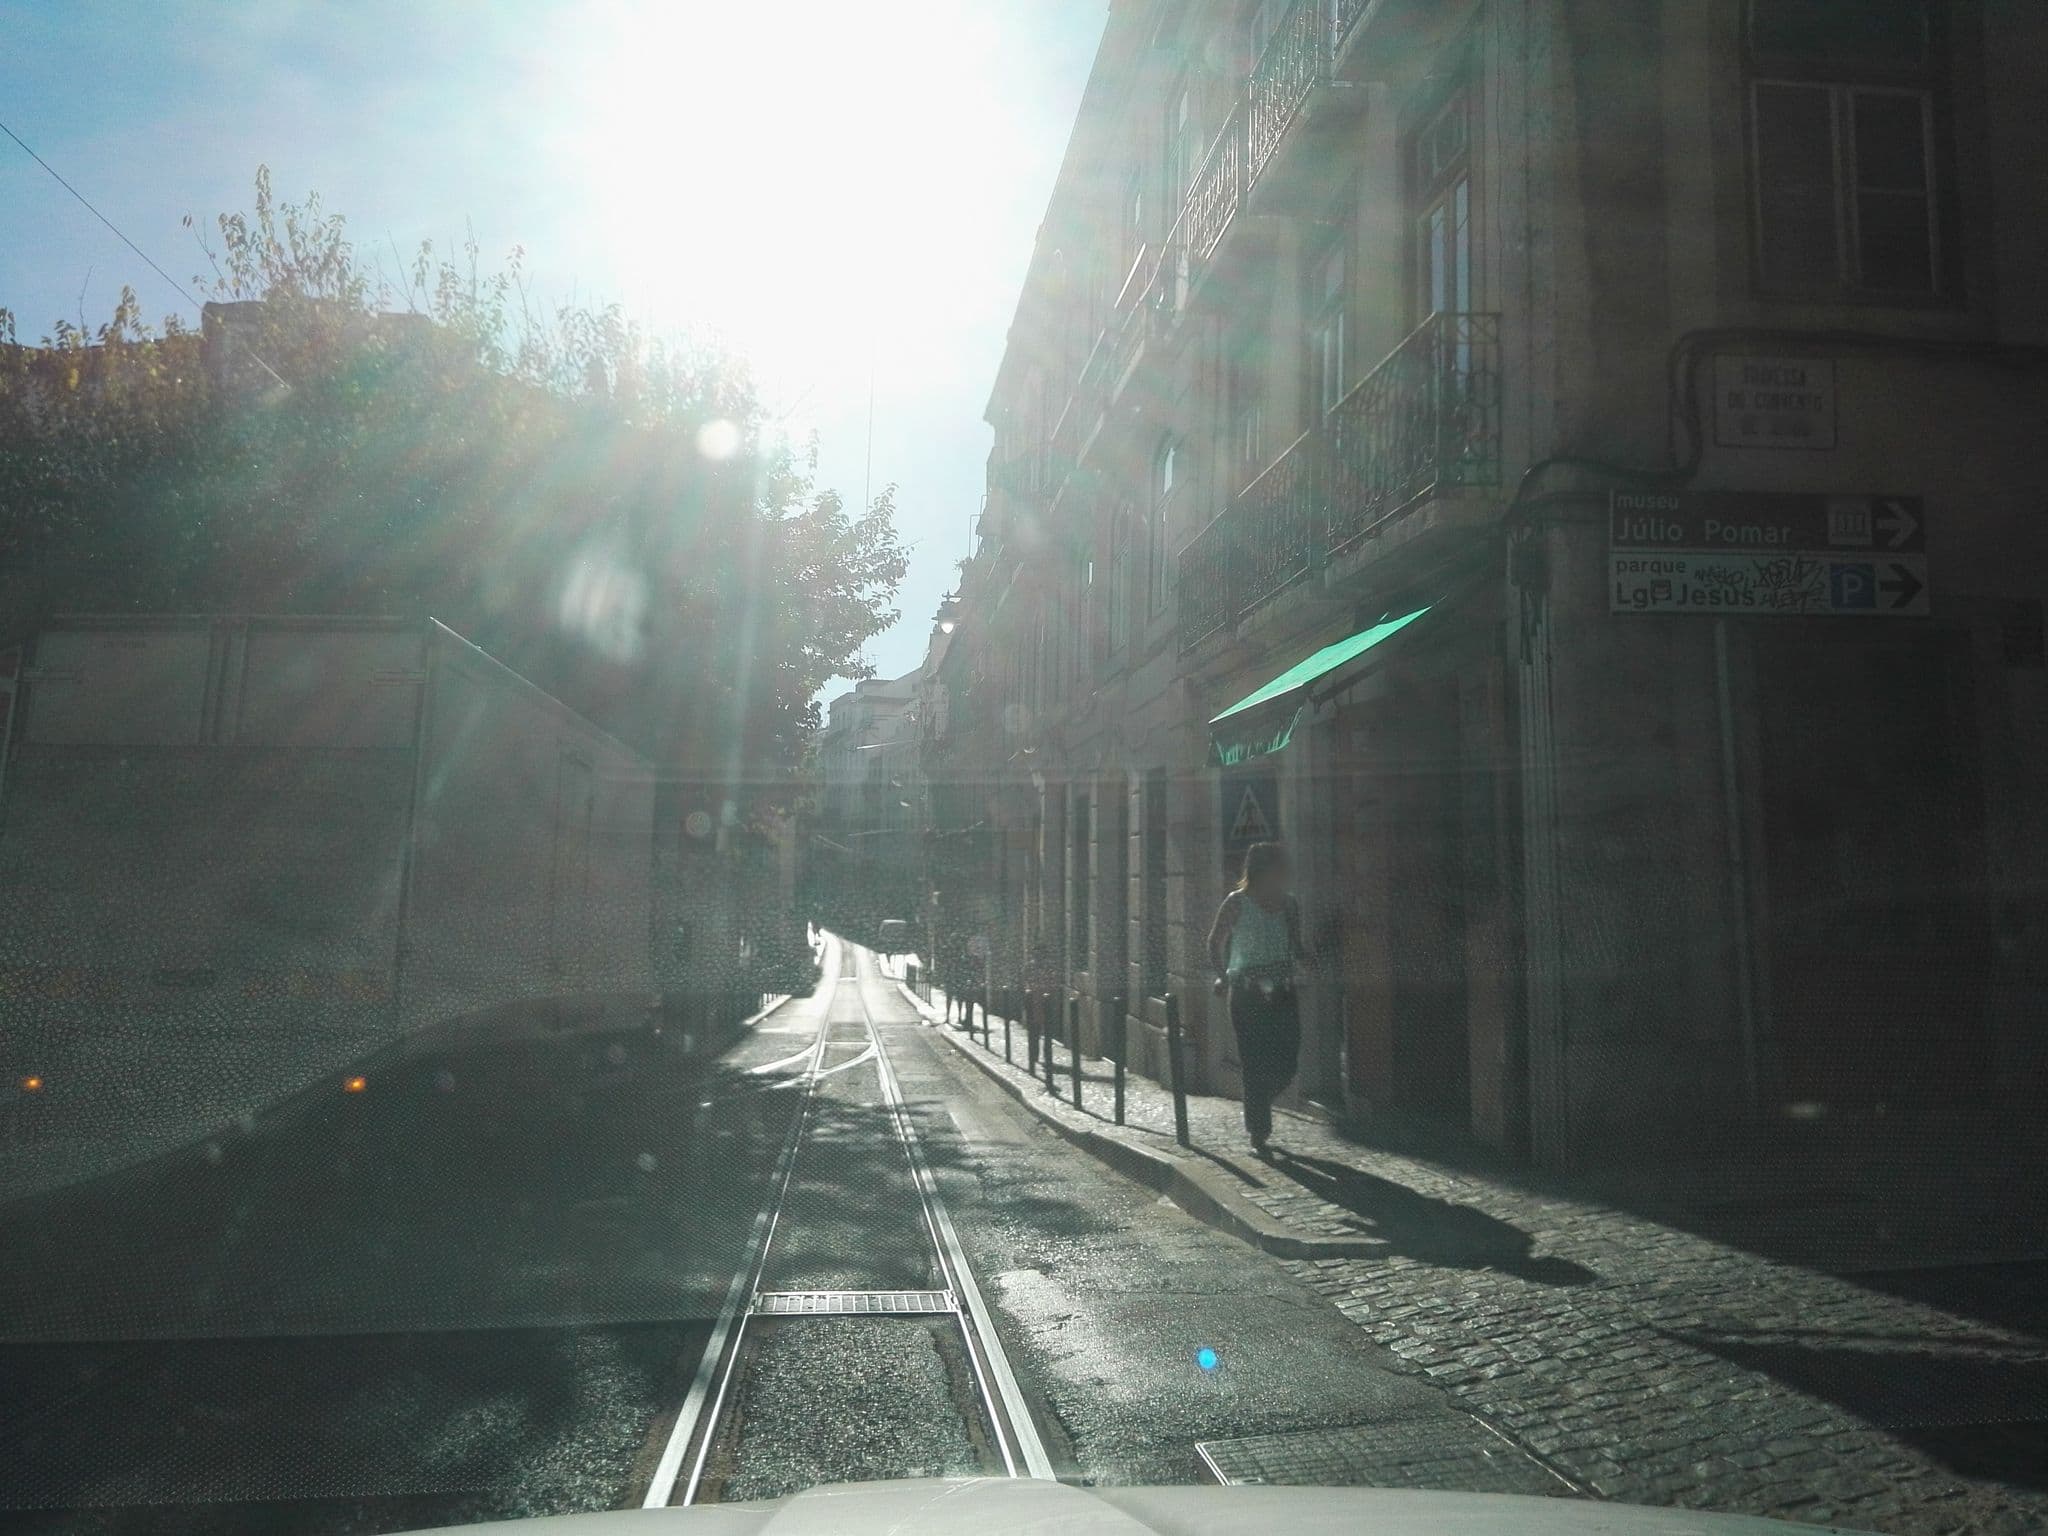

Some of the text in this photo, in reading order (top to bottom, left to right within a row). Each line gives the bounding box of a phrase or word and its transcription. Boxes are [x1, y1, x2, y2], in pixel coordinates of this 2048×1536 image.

[1616, 494, 1680, 510] museu
[1616, 517, 1792, 544] Júlio Pomar
[1616, 559, 1687, 577] parque
[1676, 584, 1757, 607] Jesus
[1841, 571, 1864, 605] P
